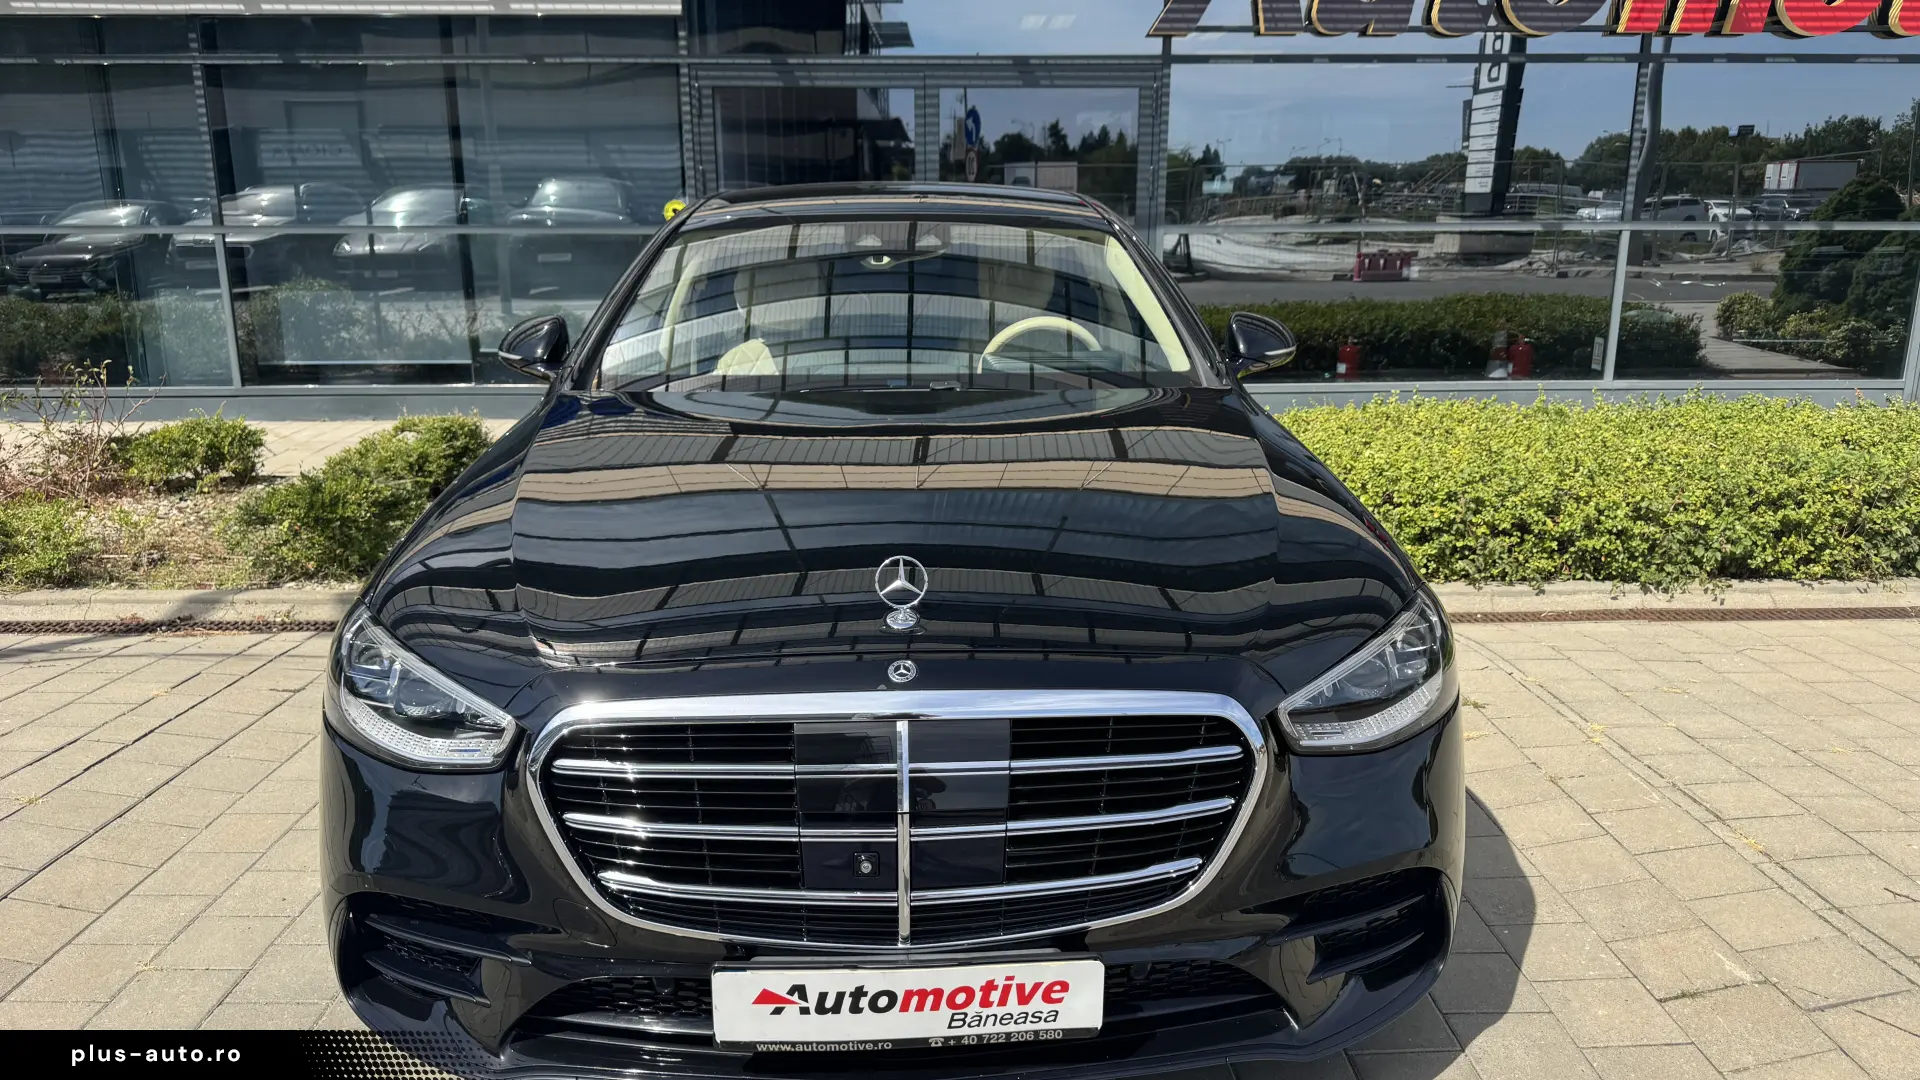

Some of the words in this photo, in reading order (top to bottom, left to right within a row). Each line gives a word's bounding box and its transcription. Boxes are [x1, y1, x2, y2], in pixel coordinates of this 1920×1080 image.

[768, 975, 1070, 1016] Automotive
[947, 1009, 1060, 1030] Băneasa
[961, 1035, 978, 1045] 40
[982, 1034, 1007, 1044] 722
[1010, 1031, 1035, 1041] 206
[1038, 1029, 1064, 1040] 580
[756, 1040, 893, 1053] www.automotive.ro
